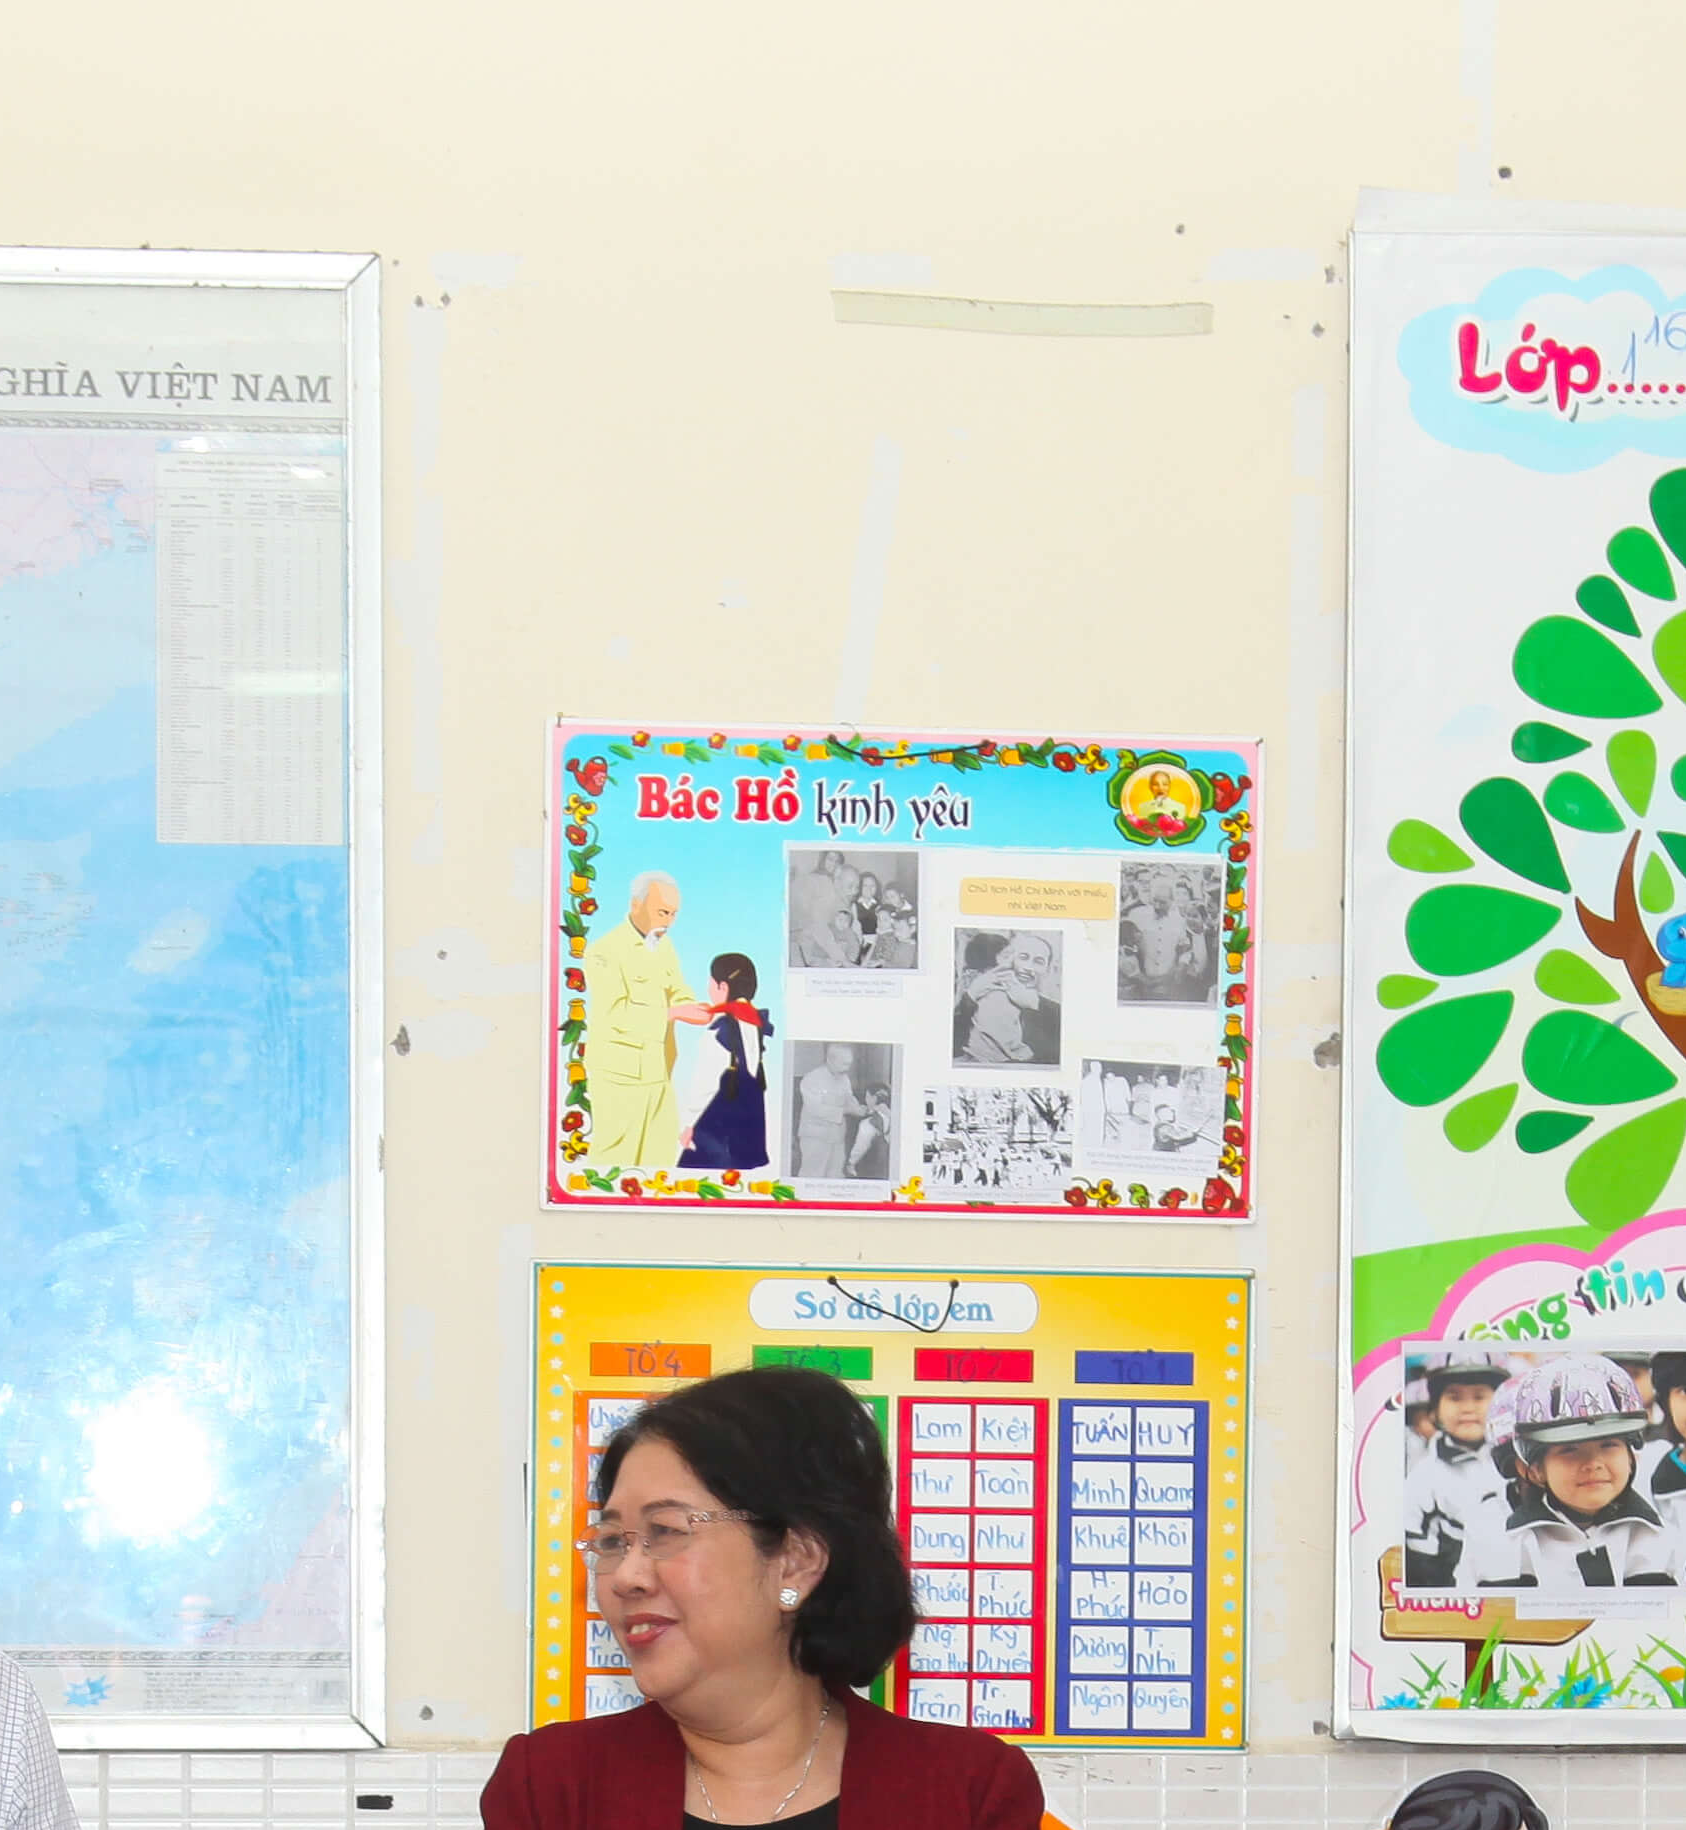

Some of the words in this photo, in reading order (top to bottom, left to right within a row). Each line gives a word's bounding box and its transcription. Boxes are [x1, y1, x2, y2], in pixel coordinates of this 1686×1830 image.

[115, 362, 219, 409] VIỆT
[231, 373, 333, 404] NAM
[637, 774, 720, 821] Bác
[733, 767, 801, 822] Hồ
[815, 779, 896, 837] kính
[908, 782, 970, 839] yêu
[1585, 1261, 1666, 1305] tin
[794, 1291, 837, 1321] Sơ
[847, 1288, 883, 1321] đồ
[894, 1292, 939, 1327] lớp
[951, 1302, 994, 1322] em
[981, 1416, 1032, 1448] Kiệt
[1137, 1422, 1195, 1448] HUY
[1072, 1478, 1126, 1505] Minh
